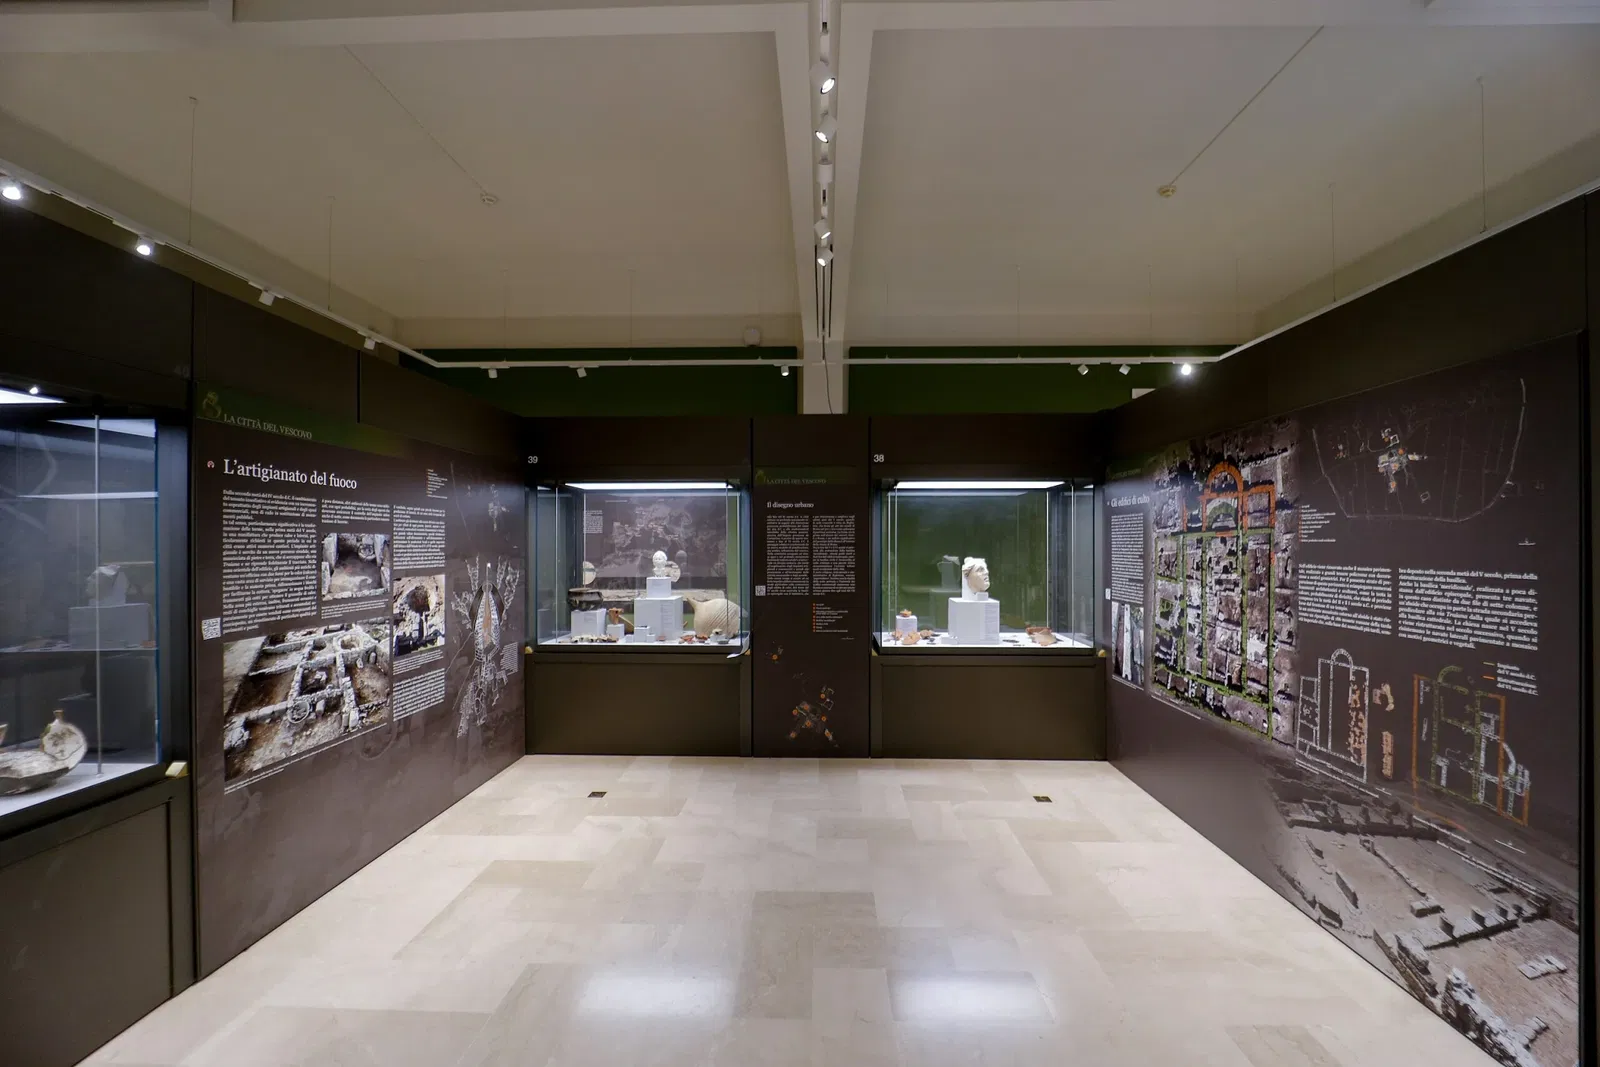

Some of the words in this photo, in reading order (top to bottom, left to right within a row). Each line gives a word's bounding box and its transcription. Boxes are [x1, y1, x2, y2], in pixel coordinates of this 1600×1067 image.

[224, 414, 236, 423] LA
[237, 416, 261, 429] CITTÀ
[263, 422, 279, 432] DEL
[280, 425, 312, 440] VESCOVO
[528, 455, 538, 464] 39
[874, 454, 884, 462] 38
[223, 458, 308, 483] L’artigianato
[310, 470, 327, 486] del
[328, 473, 357, 490] fuoco
